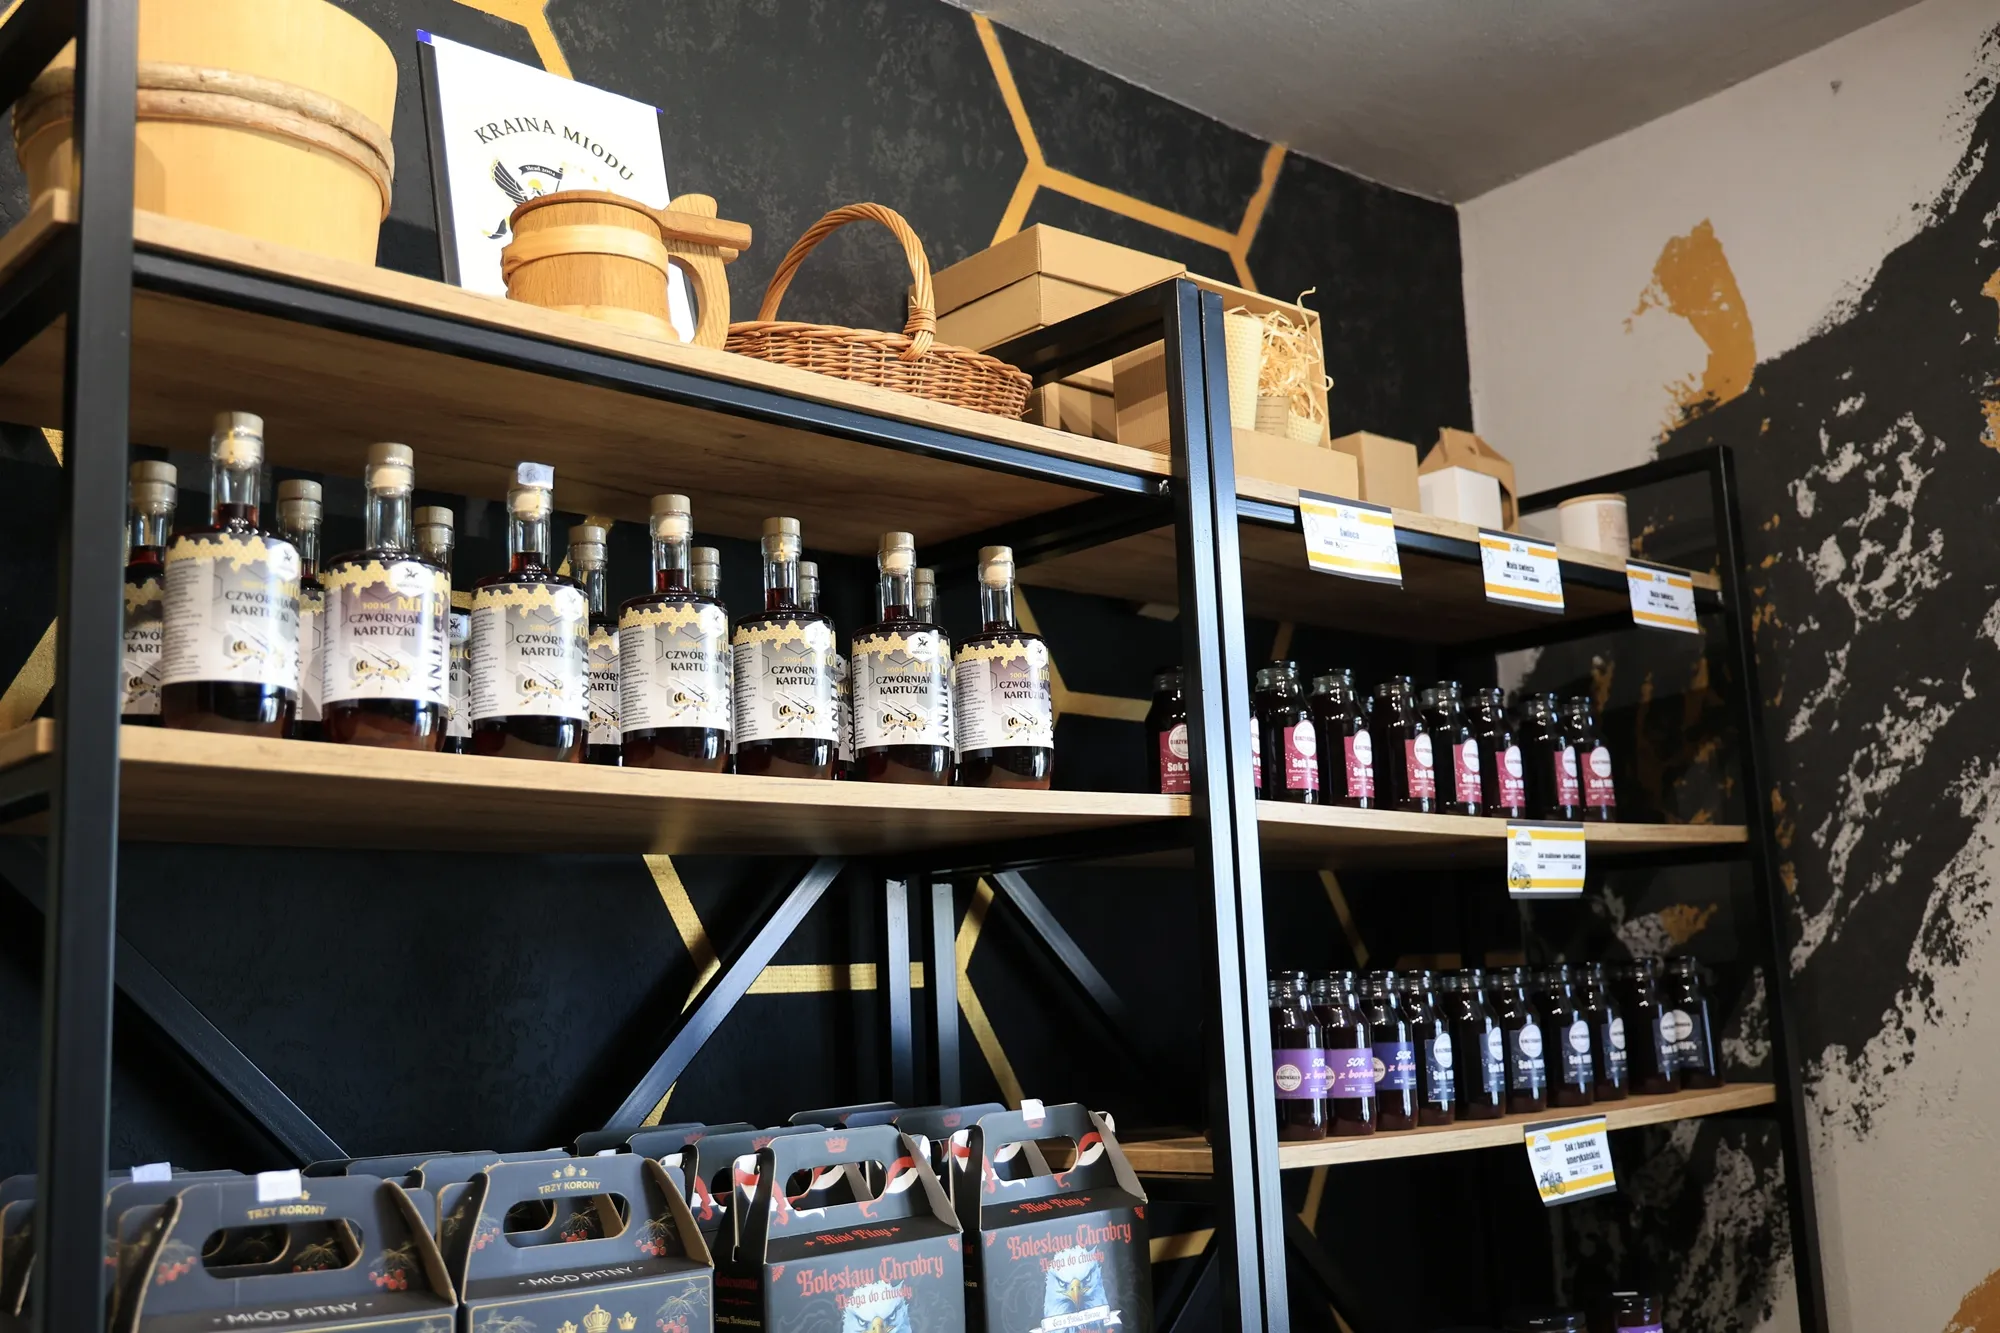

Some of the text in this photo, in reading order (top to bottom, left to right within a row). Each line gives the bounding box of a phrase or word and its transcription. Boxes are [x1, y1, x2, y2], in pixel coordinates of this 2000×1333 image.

[474, 117, 635, 181] KRAINA MIODU
[396, 596, 444, 617] MID
[354, 626, 415, 637] KARTUZKI
[876, 674, 932, 684] CZWÓRNIAK
[880, 686, 928, 695] KARTUZKI
[1167, 762, 1184, 772] Sok
[1346, 1057, 1366, 1067] SOK
[1395, 1051, 1412, 1060] SOK
[538, 1180, 601, 1194] TRZY KORONY
[247, 1204, 327, 1220] TRZY KORONY
[1076, 1221, 1132, 1248] Chrobry
[878, 1252, 944, 1285] Chrobry
[1040, 1257, 1065, 1272] Droga
[1068, 1255, 1077, 1266] do
[528, 1266, 633, 1286] MIÓD PITNY
[835, 1293, 866, 1310] Droga
[869, 1292, 880, 1303] do
[226, 1302, 358, 1324] MIÓD PITNY
